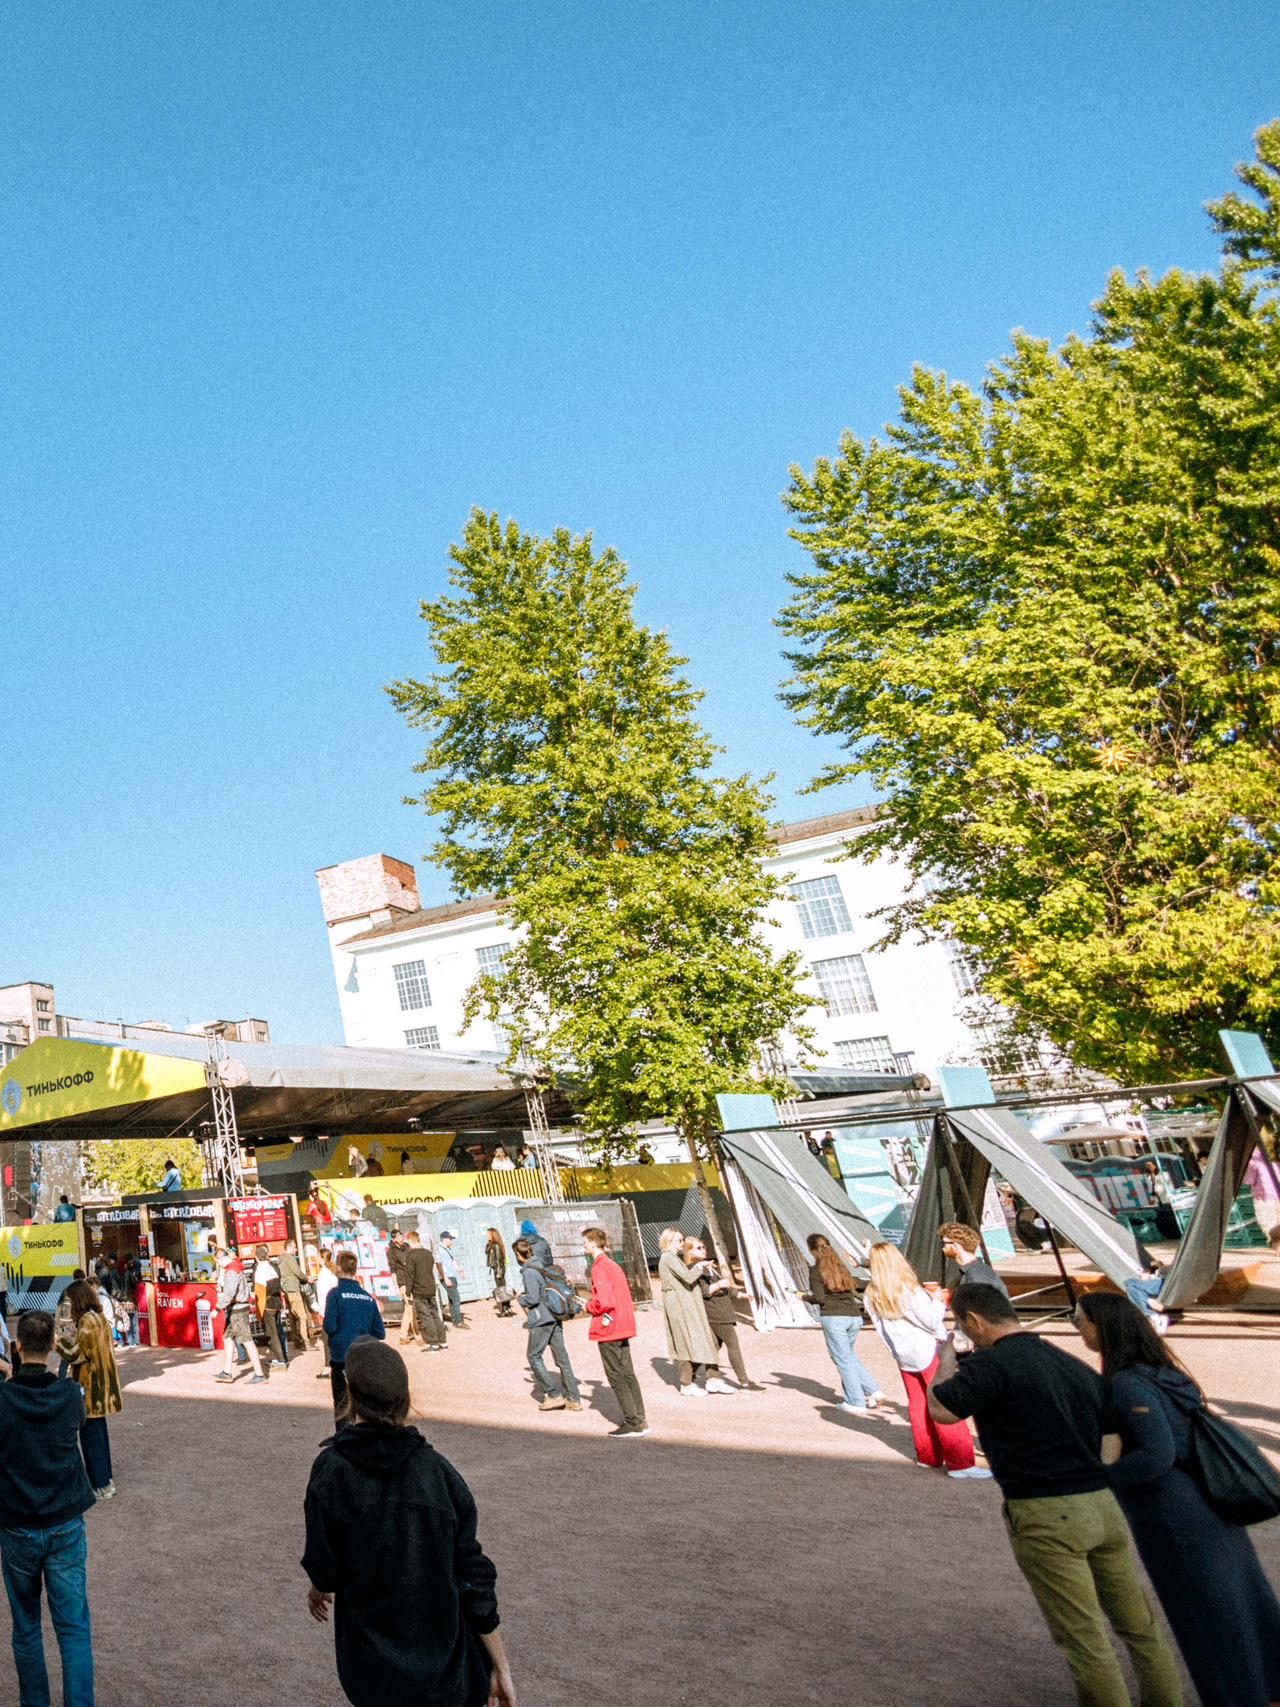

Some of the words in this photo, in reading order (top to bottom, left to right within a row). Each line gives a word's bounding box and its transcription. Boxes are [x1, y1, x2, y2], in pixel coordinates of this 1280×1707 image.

[26, 1070, 94, 1097] ТИНЬКОФФ
[386, 1145, 428, 1153] ТИНЬКОФФ
[24, 1239, 64, 1249] ТИНЬКОФФ
[342, 1292, 373, 1302] SECURITY
[157, 1298, 183, 1308] RAVEN
